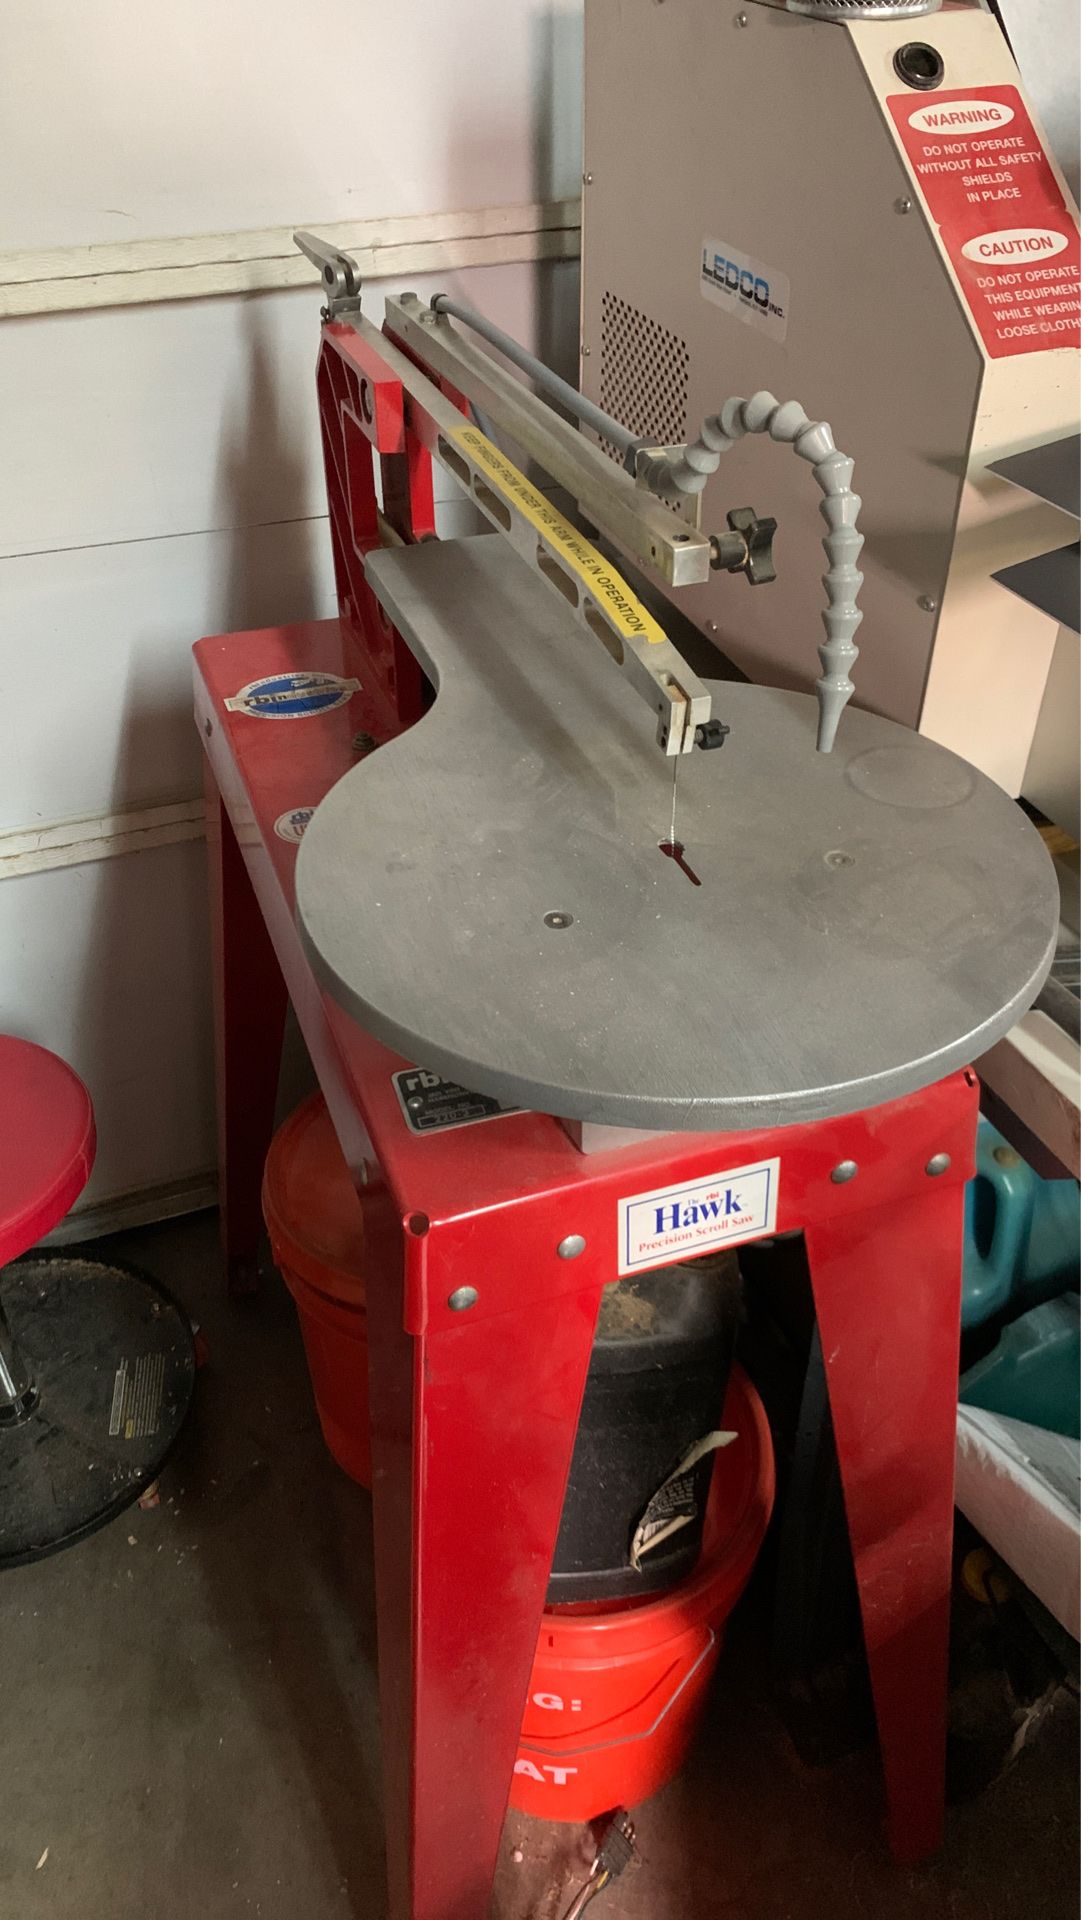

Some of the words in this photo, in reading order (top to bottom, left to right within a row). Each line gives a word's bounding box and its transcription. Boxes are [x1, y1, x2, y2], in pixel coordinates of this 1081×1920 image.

[922, 108, 1002, 127] WARNING
[922, 145, 941, 157] DO
[943, 143, 967, 155] NOT
[971, 137, 1026, 152] OPERATE
[917, 159, 971, 174] WITHOUT
[975, 157, 998, 168] ALL
[998, 151, 1042, 166] SAFETY
[962, 171, 1013, 187] SHIELDS
[966, 192, 981, 203] IN
[981, 187, 1022, 202] PLACE
[979, 236, 1054, 257] CAUTION
[702, 248, 770, 308] LEDCO
[976, 277, 995, 288] DO
[997, 273, 1022, 285] NOT
[1025, 265, 1080, 282] OPERATE
[984, 292, 1013, 305] THIS
[993, 307, 1033, 321] WHILE
[996, 324, 1039, 339] LOOSE
[1040, 318, 1081, 333] CLOTH
[461, 432, 481, 446] KEEP
[475, 445, 504, 469] FINGERS
[496, 469, 521, 487] FROM
[514, 486, 541, 509] UNDER
[535, 508, 557, 524] THIS
[550, 526, 573, 541] ARM
[566, 541, 596, 565] WHILE
[587, 564, 605, 576] IN
[597, 576, 646, 632] OPERATION
[406, 1071, 449, 1091] rb
[653, 1189, 743, 1235] Hawk
[639, 1231, 693, 1252] Precision
[696, 1219, 729, 1237] Scroll
[732, 1215, 754, 1227] Saw
[526, 1692, 582, 1712] G:
